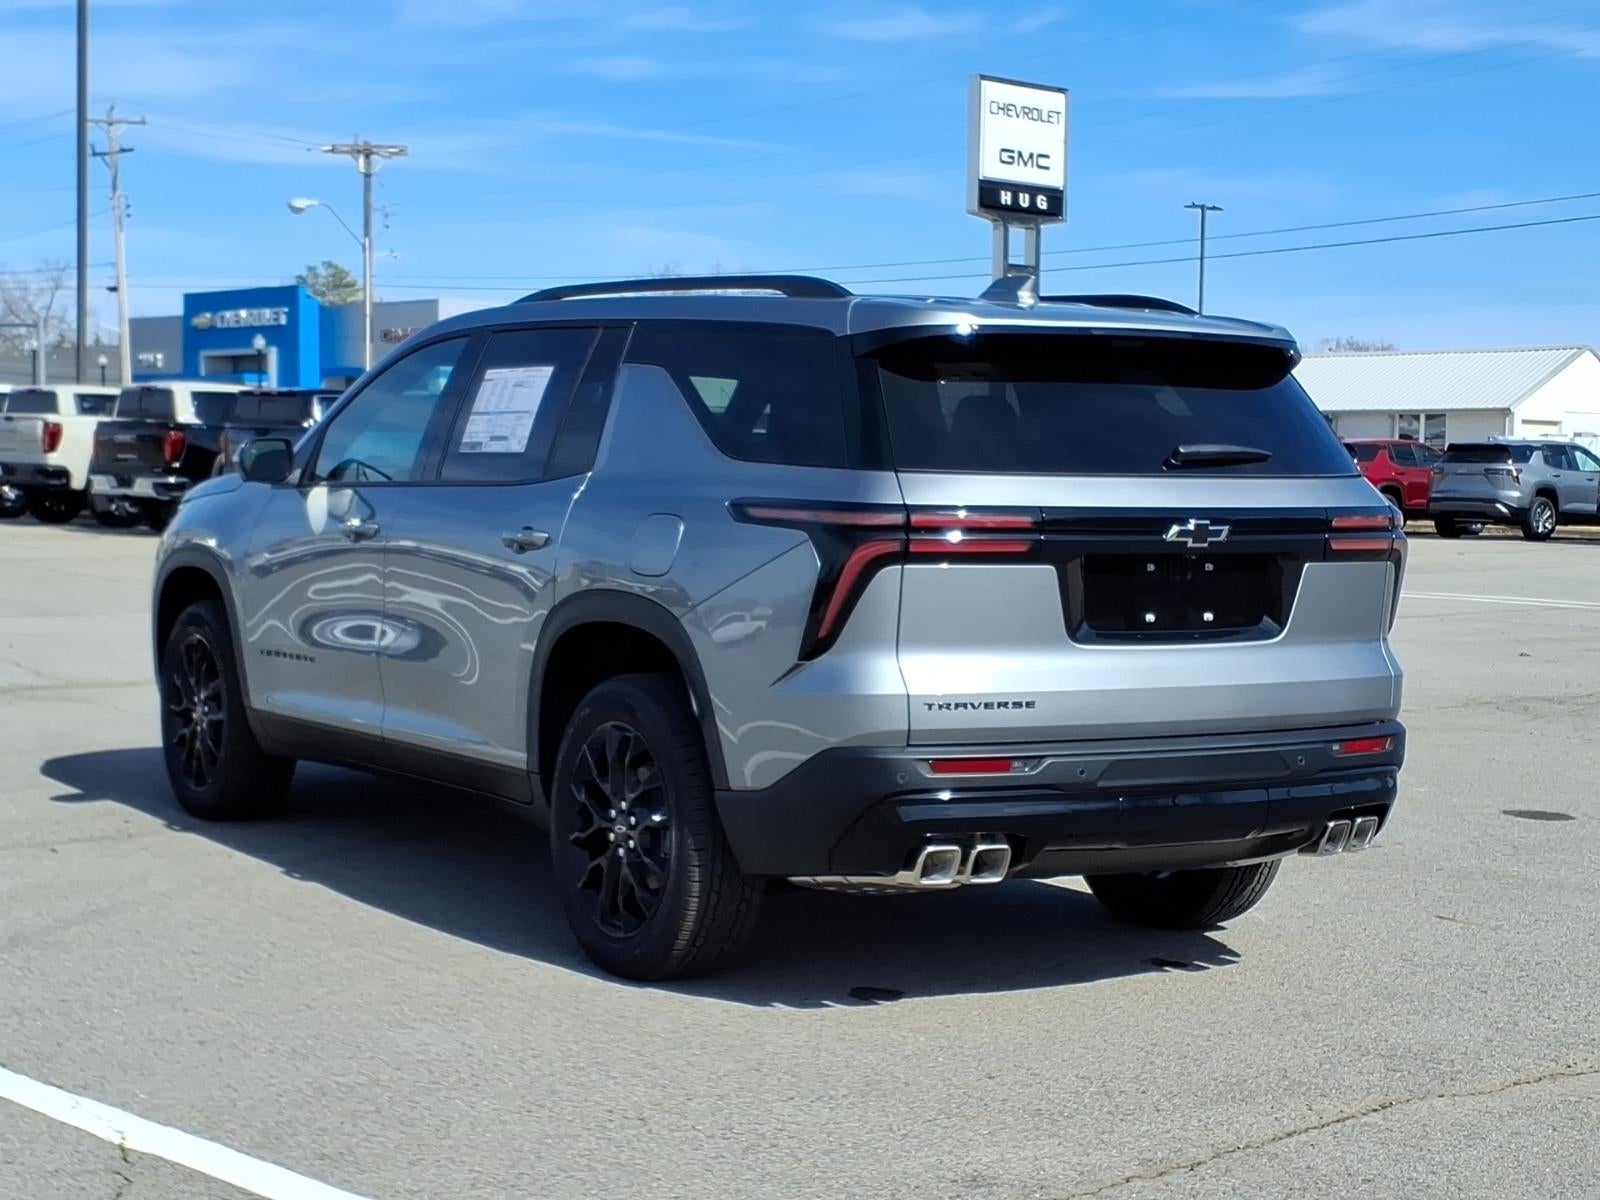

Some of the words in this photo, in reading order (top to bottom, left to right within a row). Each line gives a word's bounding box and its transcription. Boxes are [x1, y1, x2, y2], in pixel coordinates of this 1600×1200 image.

[989, 100, 1062, 125] CHEVROLET
[999, 148, 1051, 171] GMC
[1000, 190, 1048, 210] HUG
[215, 307, 288, 328] CHEVROLET
[923, 700, 1036, 711] TRAVERSE
